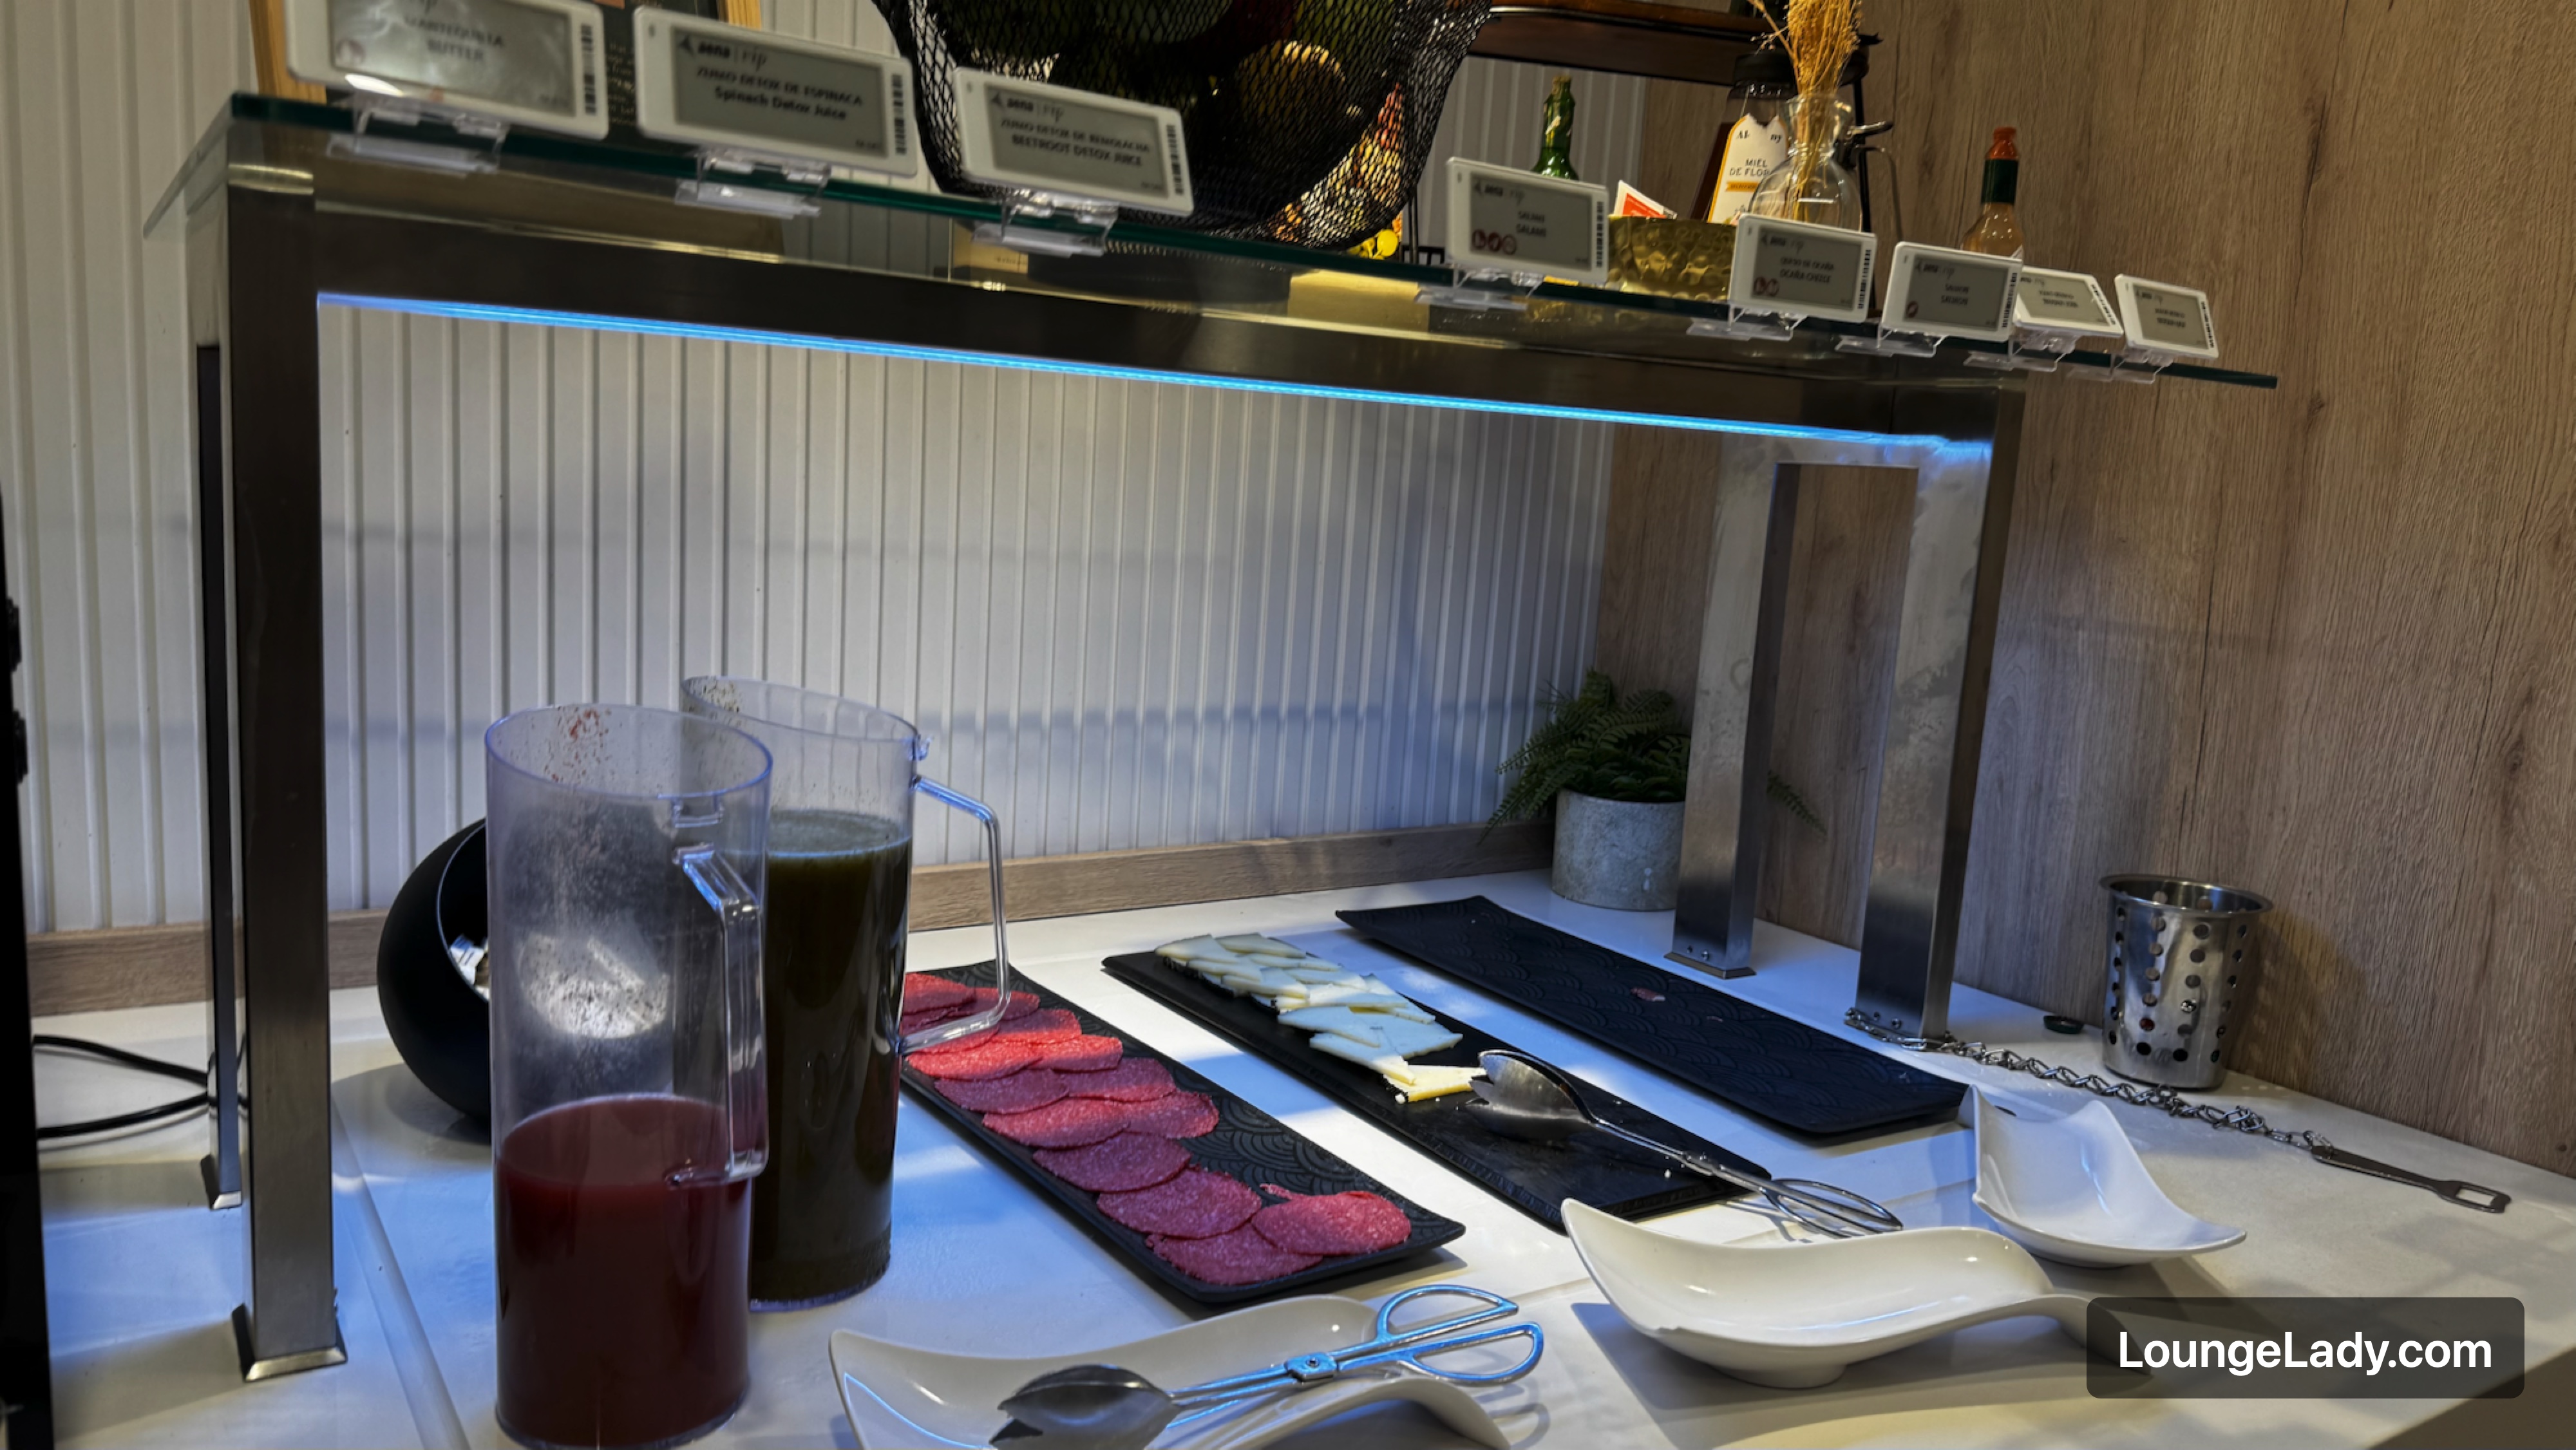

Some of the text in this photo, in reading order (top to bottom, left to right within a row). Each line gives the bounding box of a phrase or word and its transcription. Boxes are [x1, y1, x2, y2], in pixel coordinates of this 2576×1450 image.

[698, 41, 731, 59] aena
[740, 73, 781, 89] DETOX
[784, 81, 799, 94] DE
[804, 85, 864, 106] ESPINACA
[715, 86, 848, 121] Spinach Detox Juice
[1012, 133, 1070, 154] BEETROOT
[1074, 144, 1110, 161] DETOX
[1729, 167, 1742, 176] DE
[1745, 158, 1768, 168] MIEL
